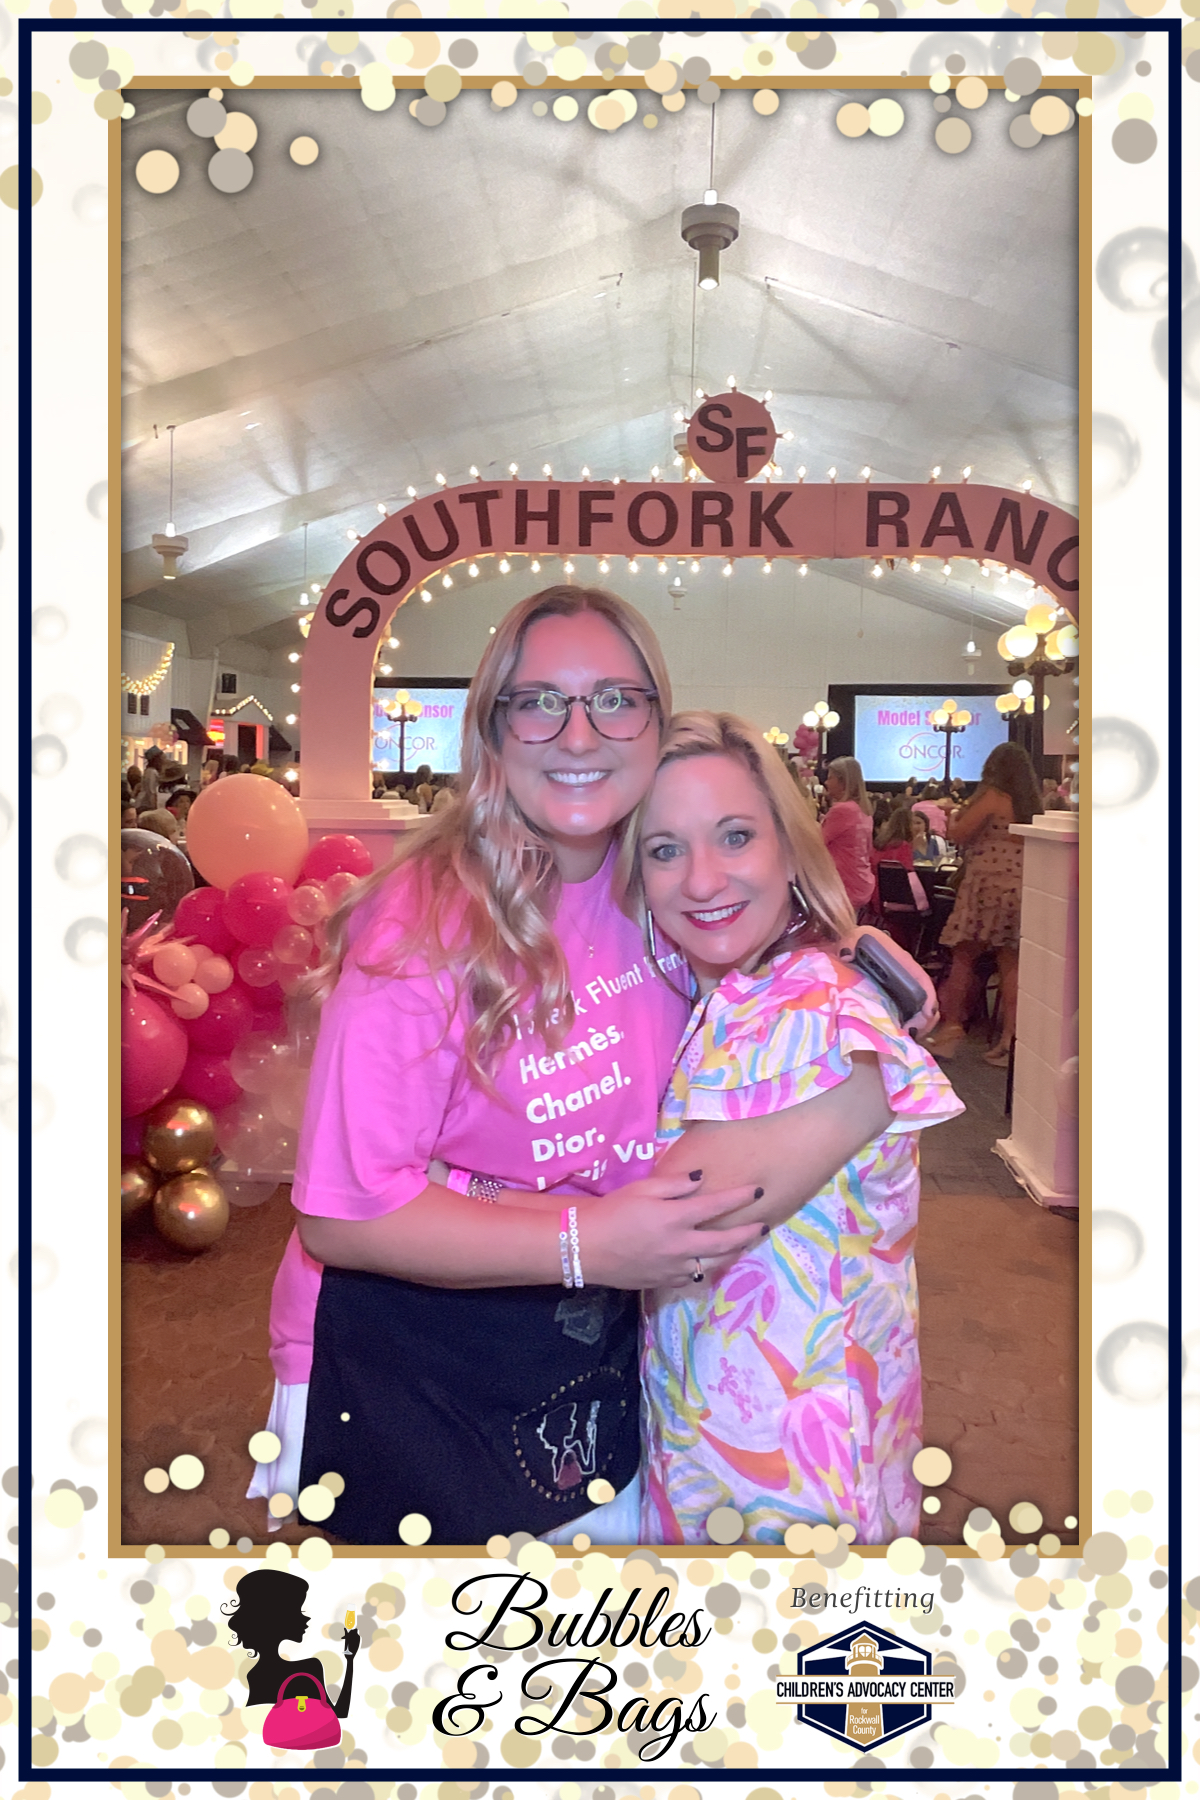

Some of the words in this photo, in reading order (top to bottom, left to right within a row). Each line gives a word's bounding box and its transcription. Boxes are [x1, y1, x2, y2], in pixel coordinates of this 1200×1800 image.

[696, 404, 768, 478] SF
[325, 489, 794, 638] SOUTHFORK
[877, 710, 921, 726] Model
[585, 963, 644, 1005] Fluent
[526, 1061, 632, 1124] Chanel.
[531, 1127, 606, 1162] Dior.
